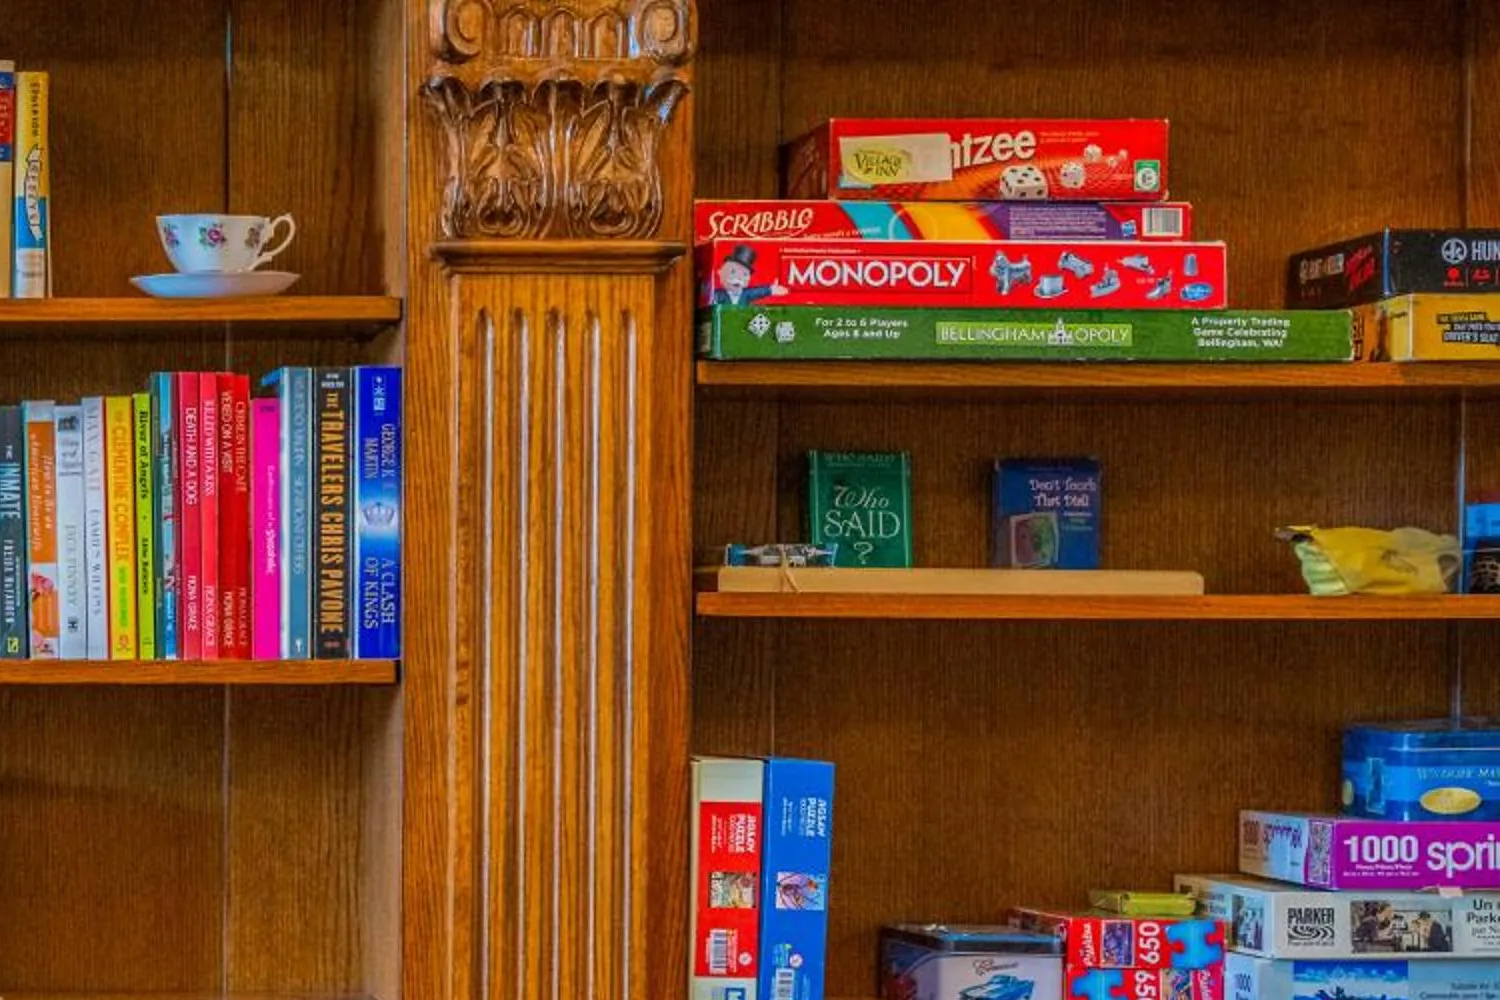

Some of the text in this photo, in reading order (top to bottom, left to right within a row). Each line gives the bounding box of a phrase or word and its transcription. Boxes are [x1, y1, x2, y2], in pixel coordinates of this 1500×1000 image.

[950, 130, 1037, 168] tzee
[708, 208, 814, 239] SCRABBLE
[787, 260, 967, 288] MONOPOLY
[815, 318, 834, 326] For
[836, 318, 842, 326] 2
[869, 318, 909, 328] Players
[823, 330, 850, 339] Ages
[862, 330, 883, 338] and
[885, 330, 900, 339] Up
[1193, 328, 1288, 338] Game Celebrating
[1202, 318, 1247, 327] Property
[1251, 318, 1291, 327] Trading
[139, 410, 148, 442] River
[185, 408, 196, 442] DEATH
[186, 445, 197, 467] AND
[321, 410, 344, 505] TRAVELERS
[363, 437, 378, 479] MARTIN
[382, 424, 395, 466] GEORGE
[0, 463, 21, 520] INMATE
[112, 425, 129, 561] CLEMENTINE COMPLEX
[139, 460, 149, 500] Angels
[186, 480, 197, 505] DOG
[833, 484, 890, 509] Who
[1034, 495, 1061, 507] That
[824, 511, 901, 539] SAID
[853, 542, 873, 565] ?
[321, 512, 343, 633] CHRIS PAVONE
[363, 556, 378, 629] OF KINGS
[382, 572, 395, 623] CLASH
[1344, 836, 1419, 863] 1000
[1287, 908, 1335, 923] PARKER
[1473, 899, 1493, 911] Un
[1138, 921, 1161, 965] 650
